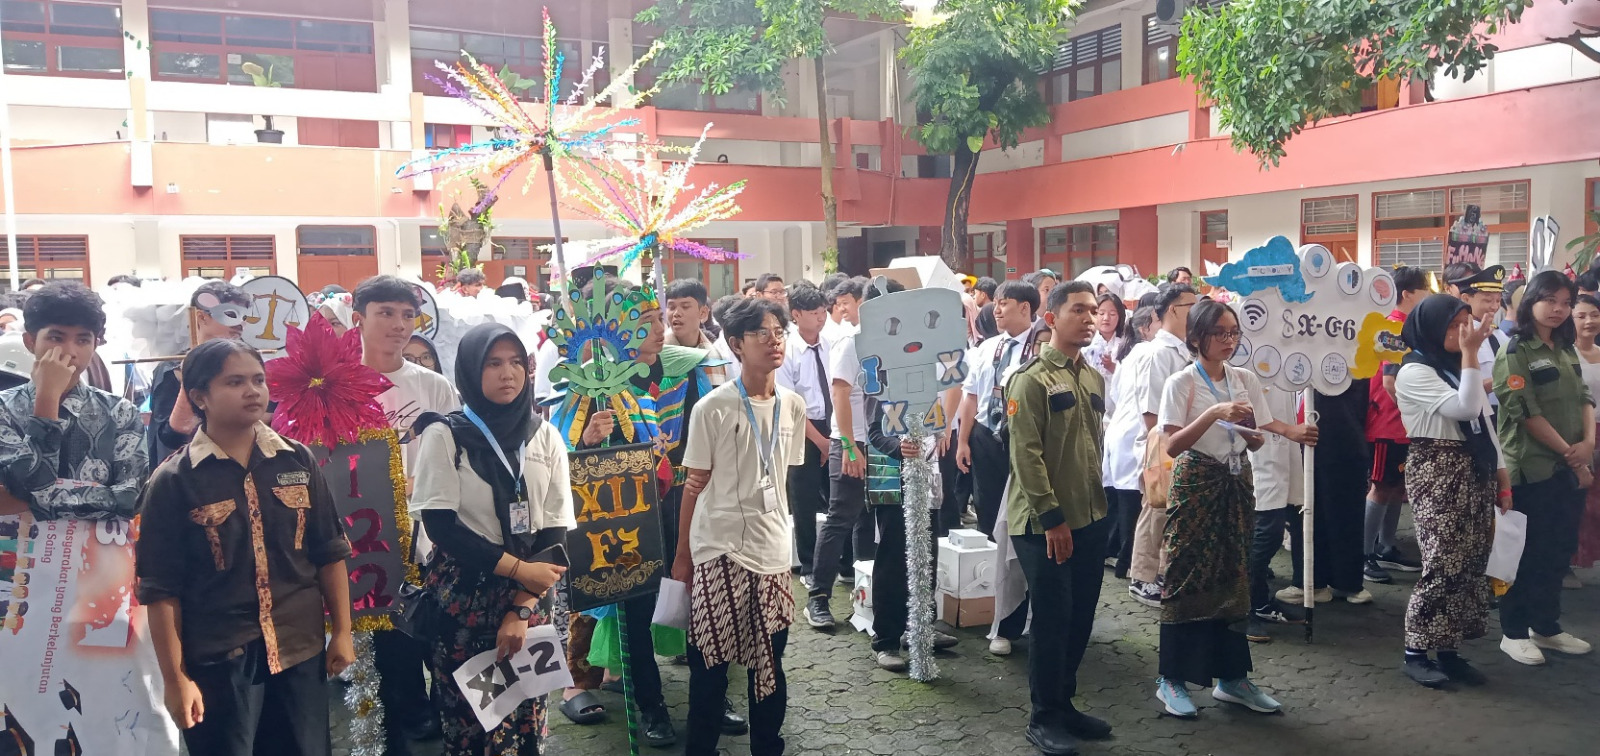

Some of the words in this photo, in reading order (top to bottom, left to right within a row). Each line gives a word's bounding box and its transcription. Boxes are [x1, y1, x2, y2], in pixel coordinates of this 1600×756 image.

[937, 349, 965, 385] X
[881, 401, 909, 437] X
[923, 398, 946, 431] 4
[572, 473, 651, 522] XII
[40, 533, 57, 564] Saing
[57, 519, 77, 586] Masyarakat
[586, 527, 642, 571] F3
[50, 586, 66, 613] yang
[38, 615, 62, 694] Berkelanjutan
[465, 640, 561, 711] XI-2
